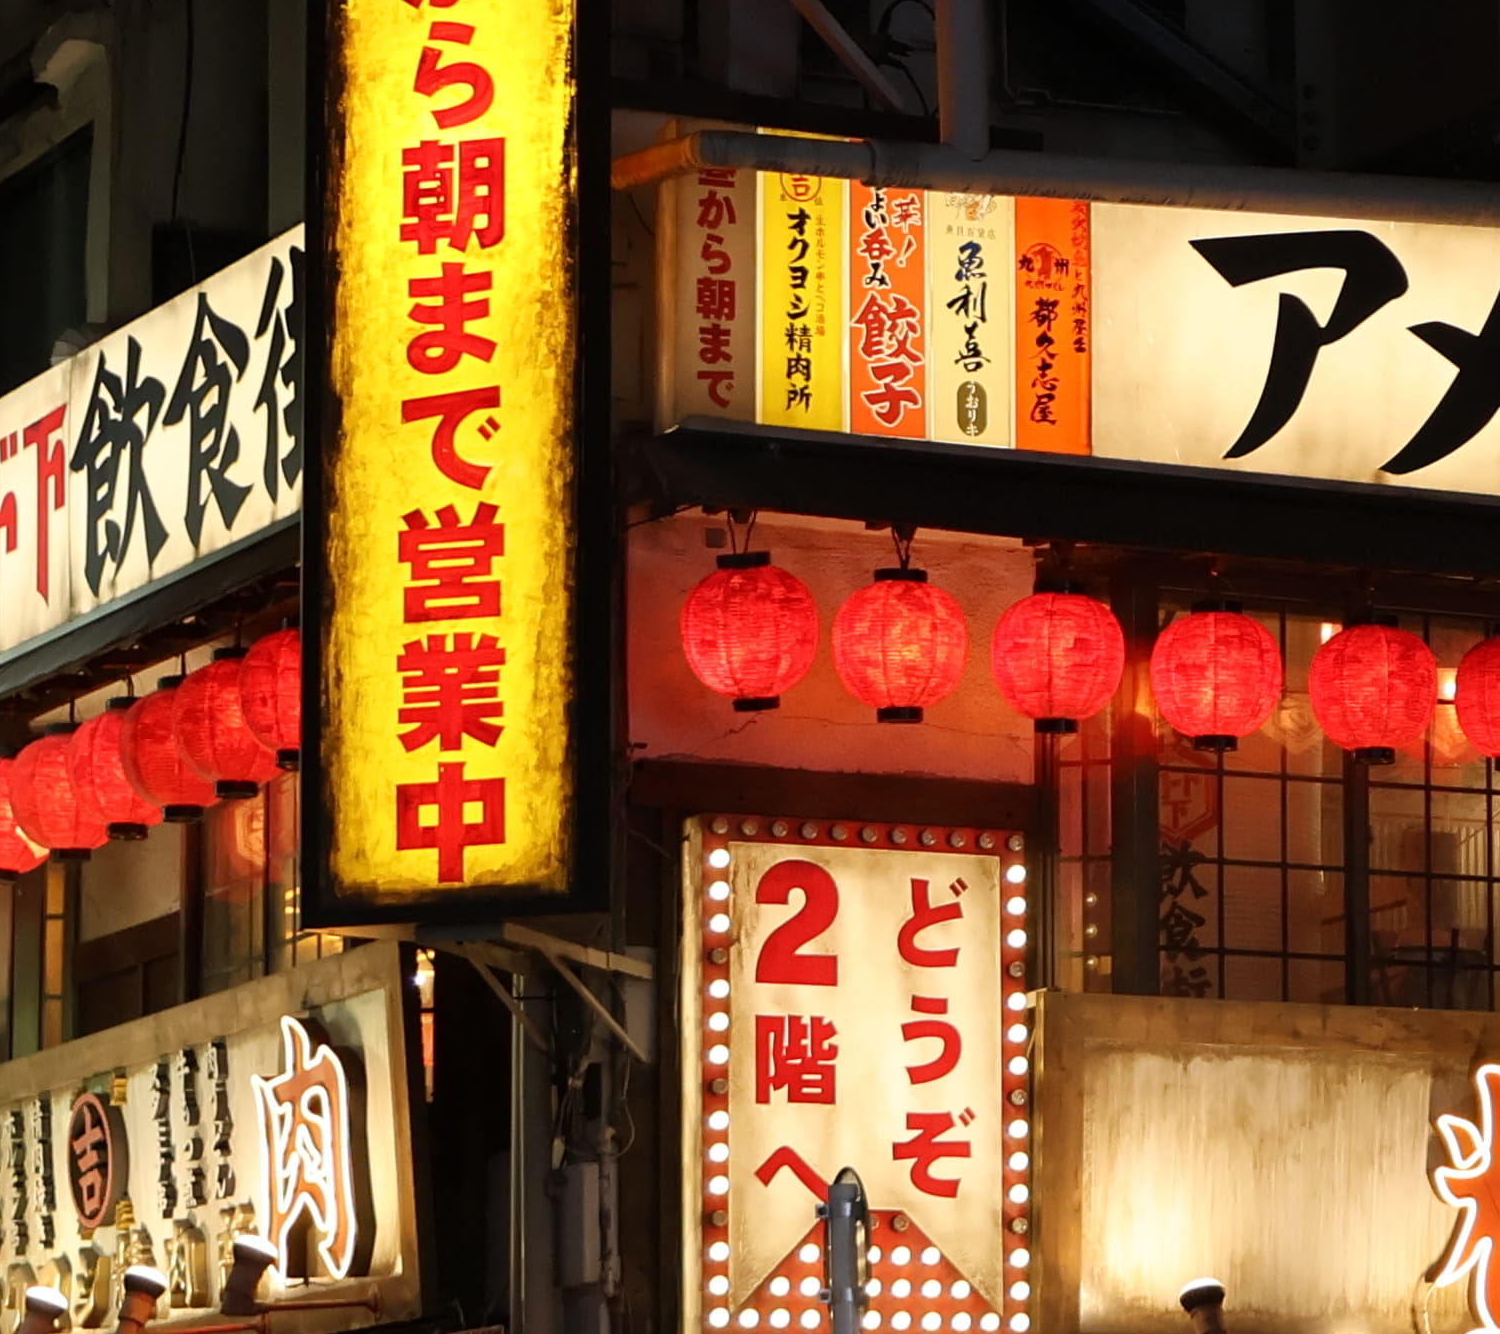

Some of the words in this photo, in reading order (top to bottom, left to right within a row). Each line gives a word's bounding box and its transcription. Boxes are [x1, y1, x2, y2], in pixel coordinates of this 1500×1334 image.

[784, 207, 813, 414] オクヨシ精肉所
[853, 292, 925, 426] 餃子
[946, 241, 992, 373] 魚利喜
[1028, 296, 1059, 426] 都久志屋
[754, 858, 840, 1202] 2階へ
[892, 876, 972, 1199] どうぞ
[69, 1097, 109, 1223] 吉
[251, 1014, 357, 1281] 肉
